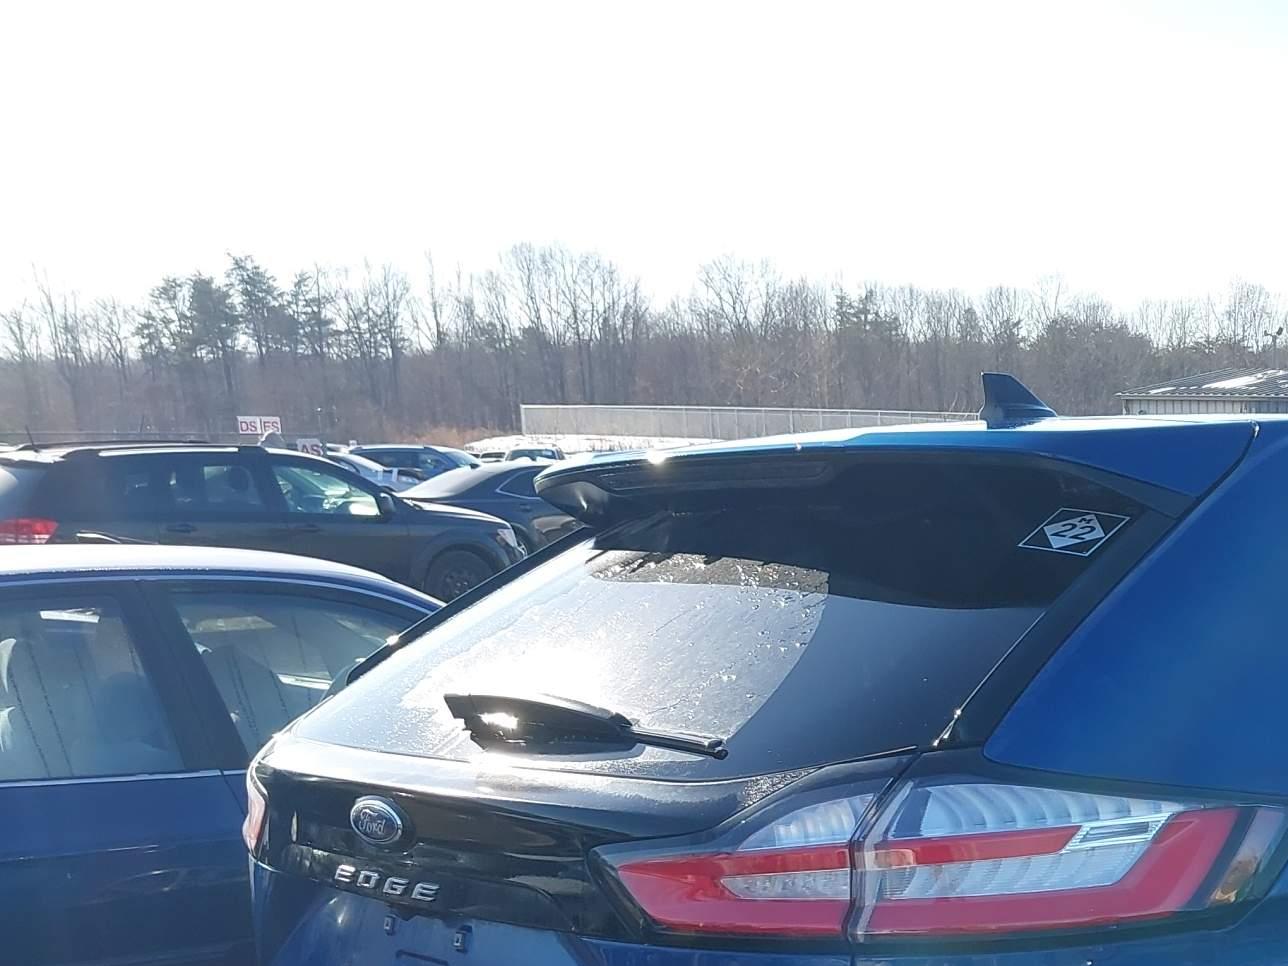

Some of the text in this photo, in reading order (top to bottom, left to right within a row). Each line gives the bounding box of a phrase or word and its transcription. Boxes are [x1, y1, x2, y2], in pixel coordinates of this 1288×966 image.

[240, 421, 257, 432] DS
[1050, 522, 1097, 540] 22
[358, 808, 386, 835] Ford
[334, 864, 440, 902] EDGE
